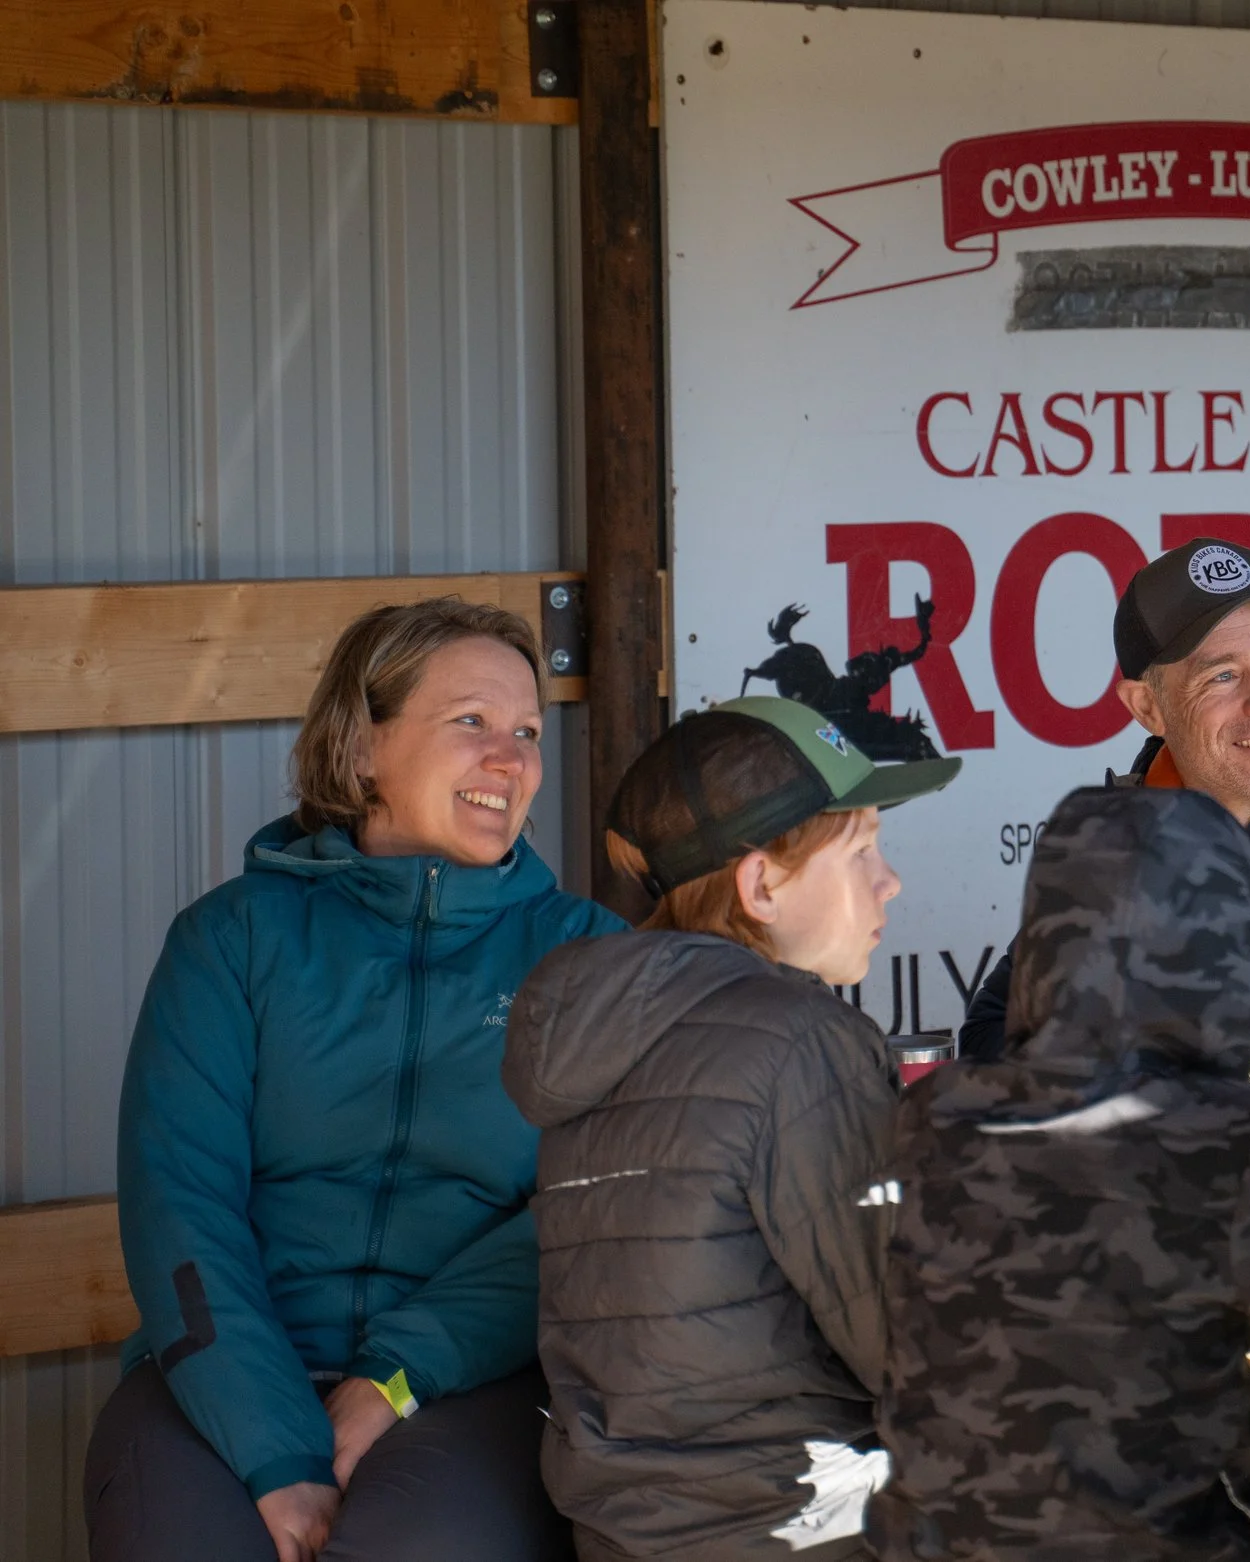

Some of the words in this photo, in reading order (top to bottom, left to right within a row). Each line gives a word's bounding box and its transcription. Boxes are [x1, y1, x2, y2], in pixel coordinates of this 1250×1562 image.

[981, 151, 1178, 218] COWLEY
[1195, 547, 1215, 560] BIKES
[1216, 547, 1242, 563] CANADA
[1191, 558, 1200, 573] KIDS
[1202, 559, 1242, 584] KBC
[834, 946, 995, 1036] ULY
